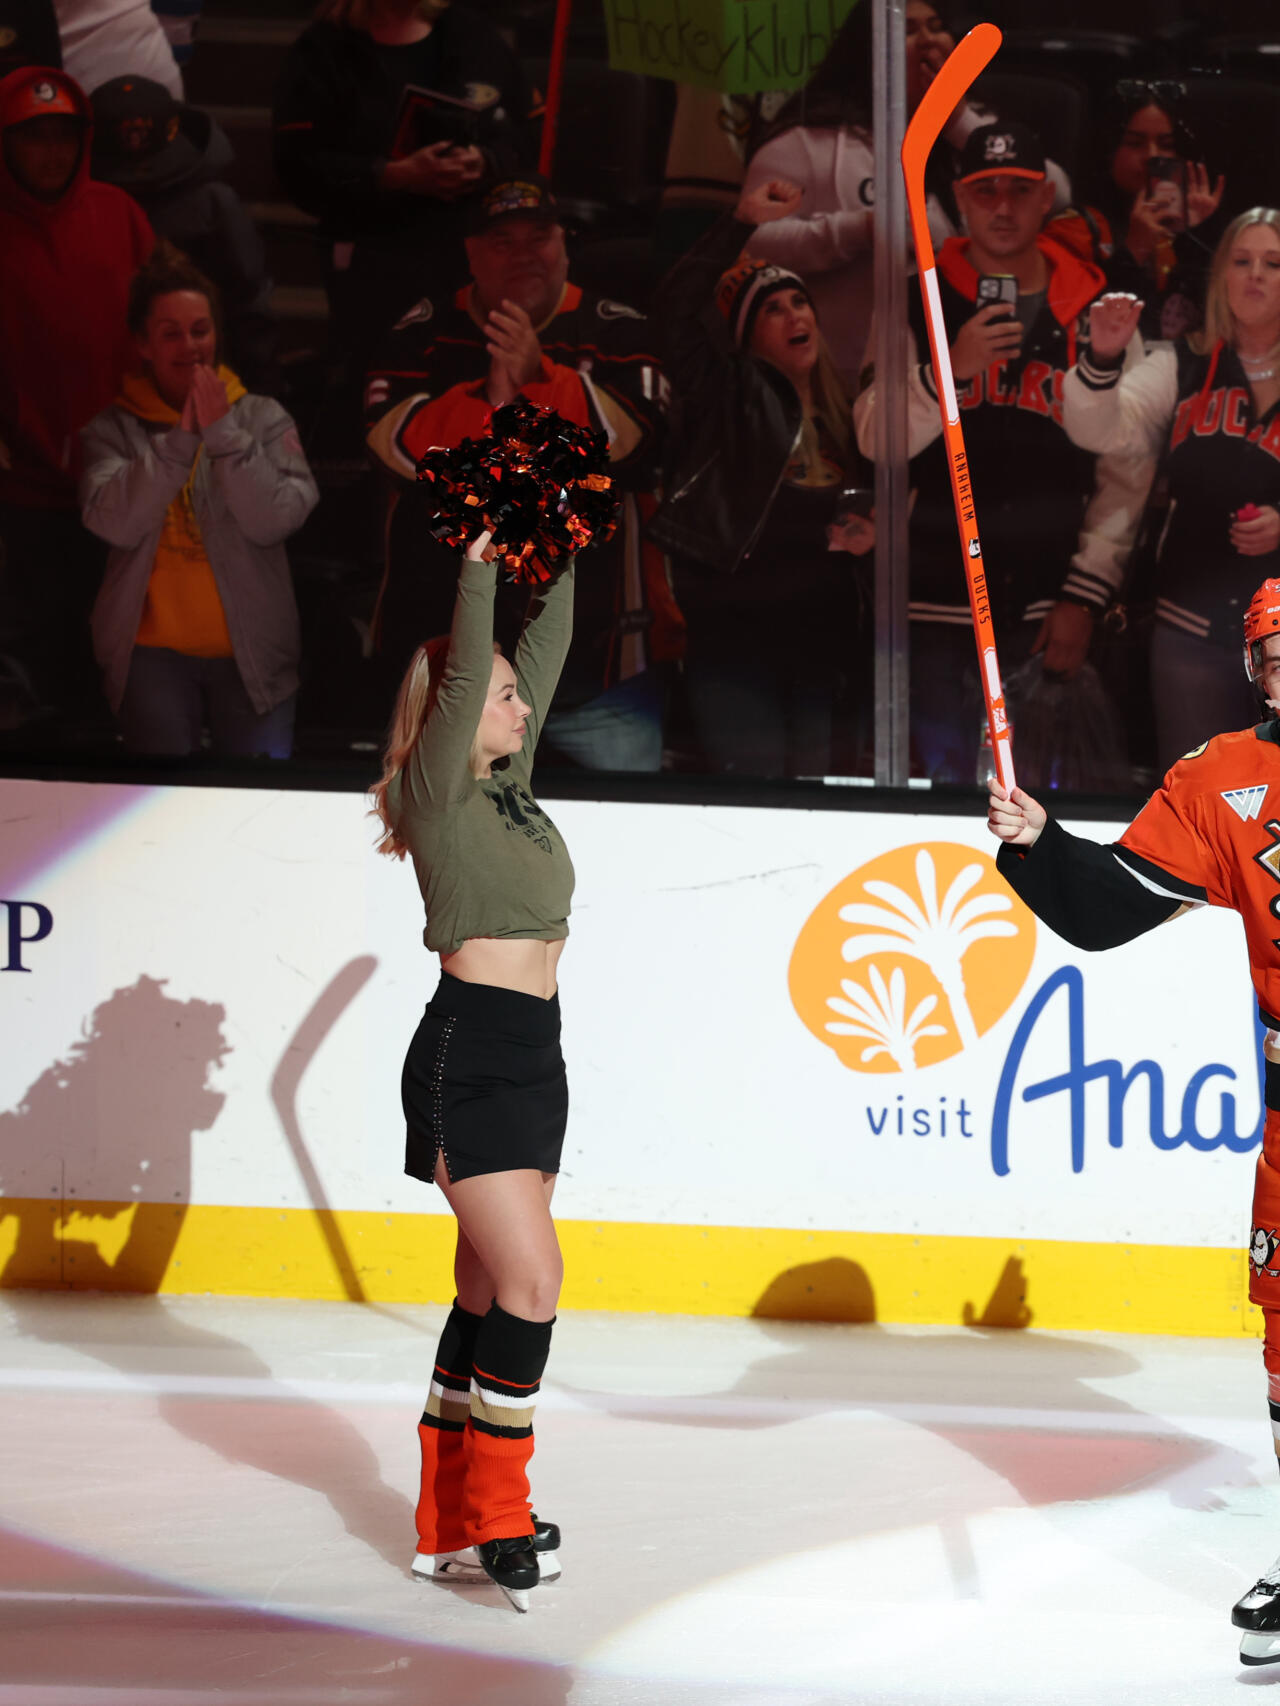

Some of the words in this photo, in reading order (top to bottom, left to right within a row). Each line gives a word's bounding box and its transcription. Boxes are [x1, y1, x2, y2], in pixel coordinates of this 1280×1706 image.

[956, 358, 1065, 426] UCKS
[953, 452, 976, 522] ANAHEIM
[973, 574, 991, 625] DUCKS
[866, 1095, 974, 1139] visit
